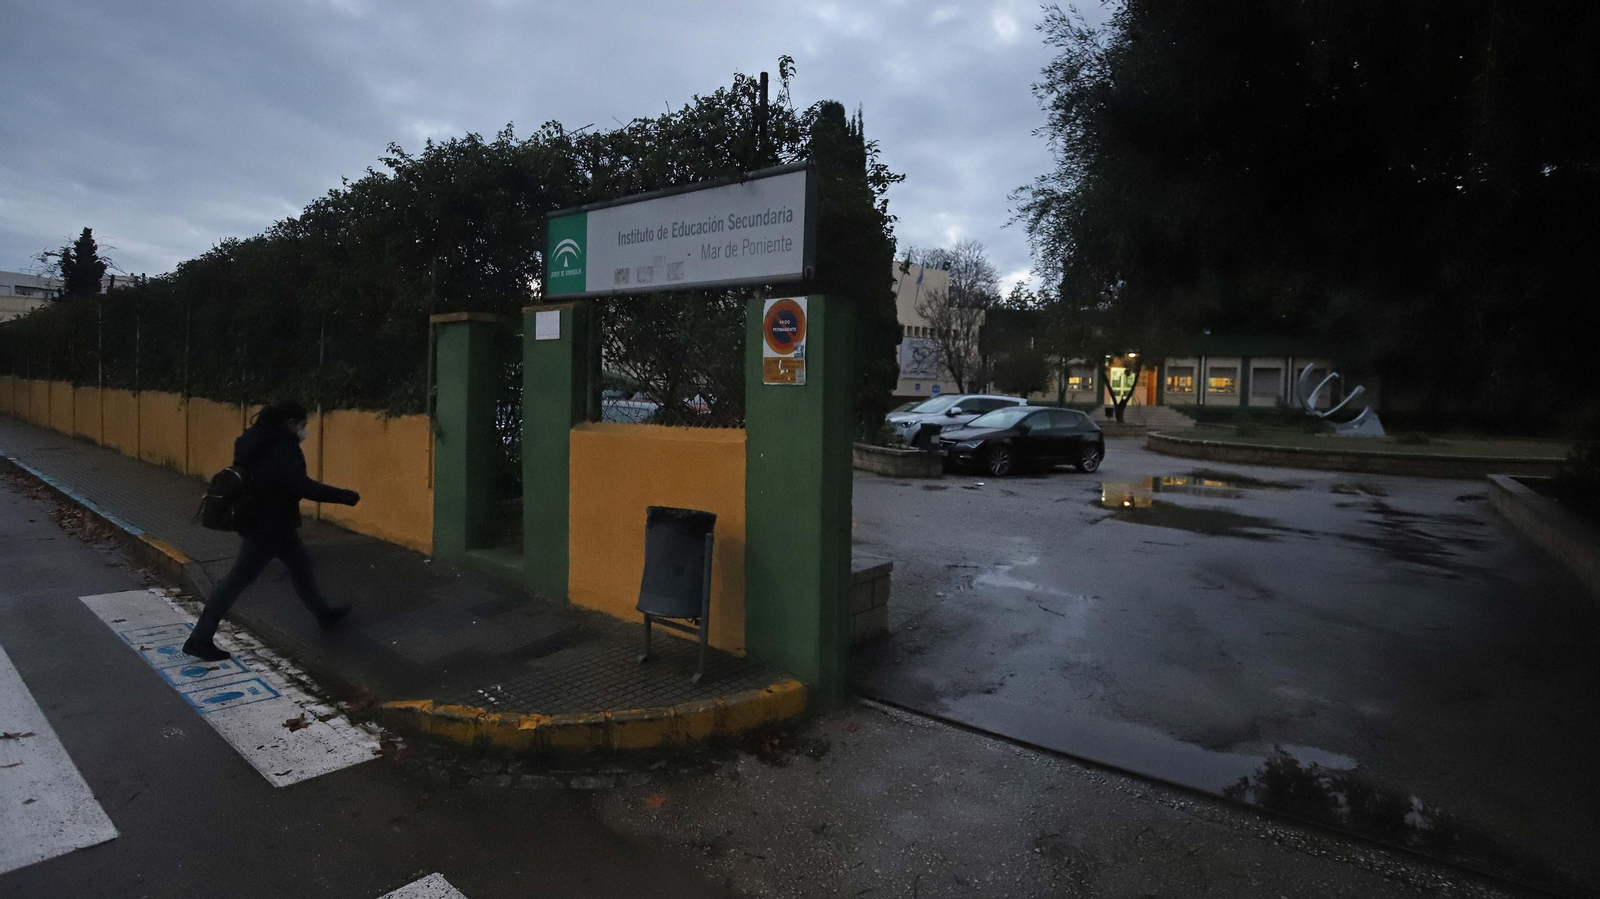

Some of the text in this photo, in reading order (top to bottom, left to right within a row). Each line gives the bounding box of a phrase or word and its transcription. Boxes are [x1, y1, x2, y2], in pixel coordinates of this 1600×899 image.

[618, 206, 793, 246] Instituto de Educación Secundaria
[701, 235, 793, 261] Mar de Poniente
